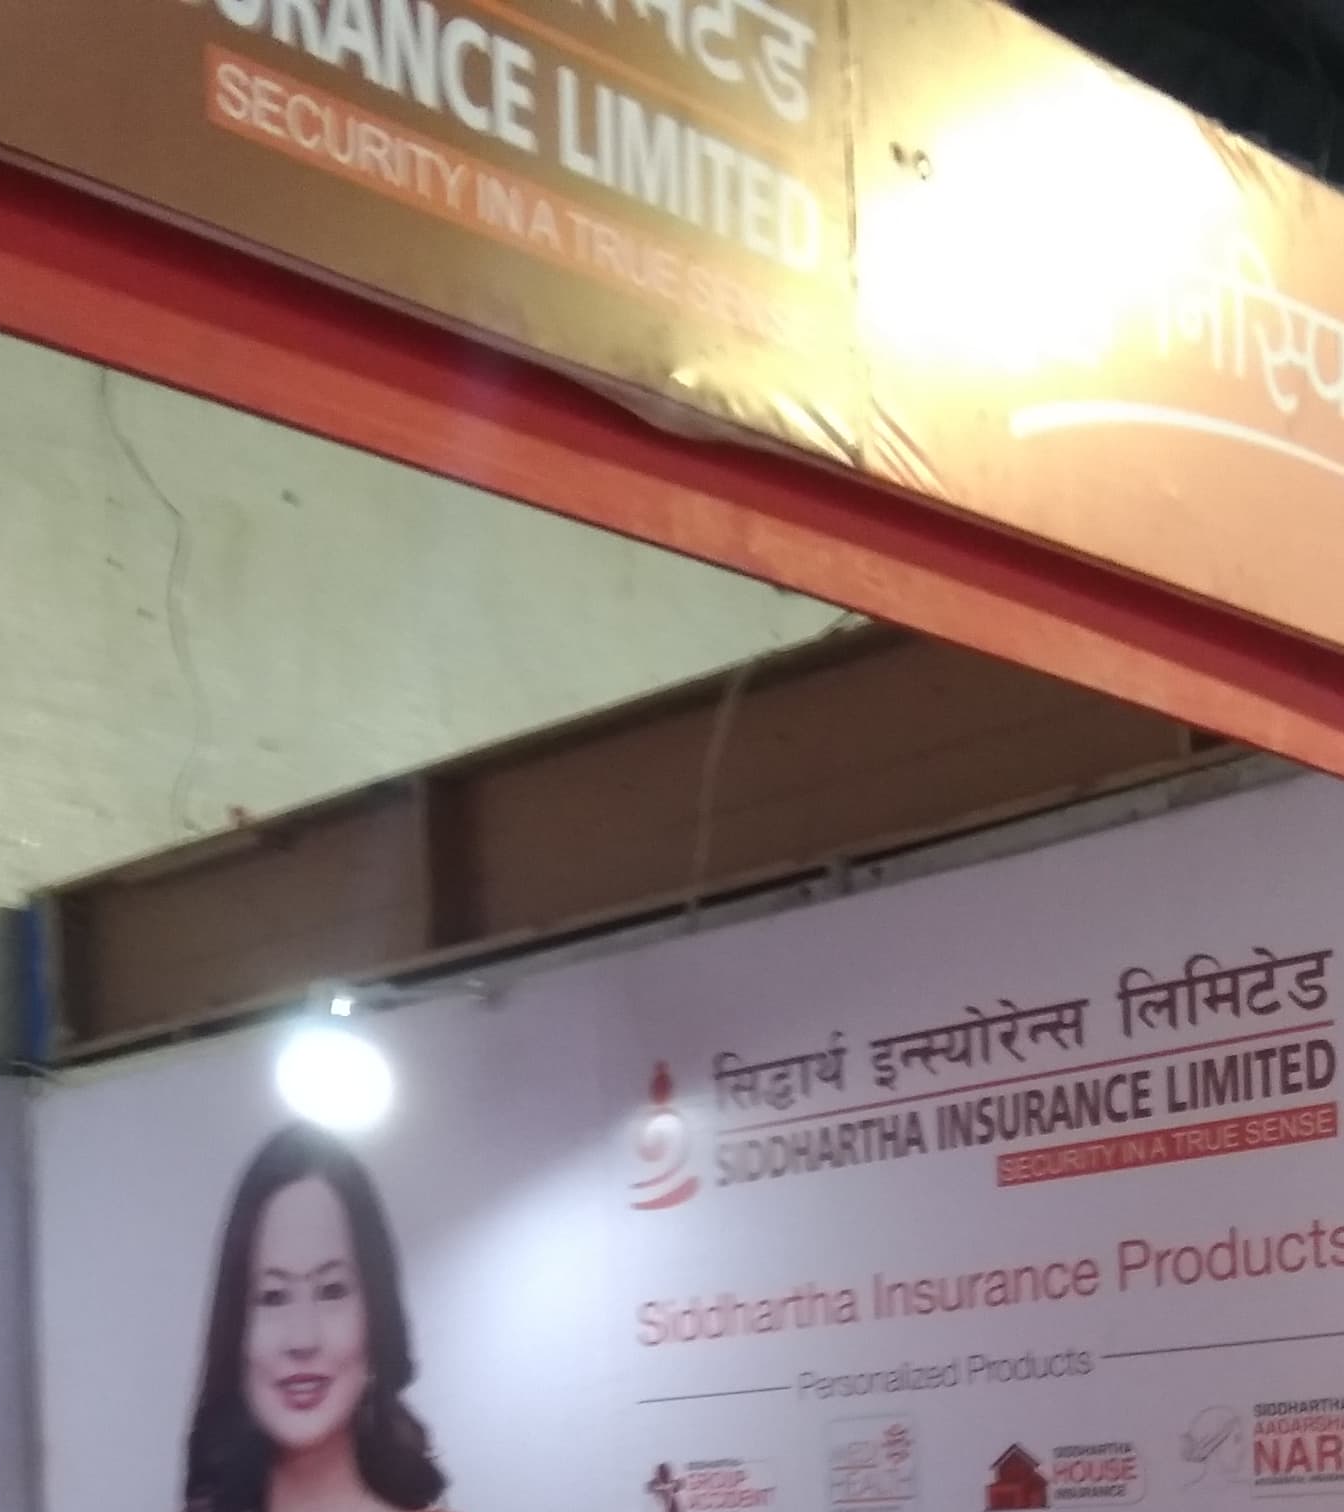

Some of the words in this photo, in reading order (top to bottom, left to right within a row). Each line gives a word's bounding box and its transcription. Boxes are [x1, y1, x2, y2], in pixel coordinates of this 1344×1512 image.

[215, 62, 468, 213] SECURITY
[474, 178, 522, 237] IN
[521, 194, 564, 252] A
[567, 211, 680, 302] TRUE
[558, 64, 824, 274] LIMITED
[1116, 946, 1334, 1038] लिमिटेड
[716, 1110, 928, 1187] SIDDHARTHA
[936, 1068, 1154, 1151] INSURANCE
[1166, 1037, 1337, 1114] LIMITED
[999, 1143, 1115, 1183] SECURITY
[1119, 1139, 1147, 1164] IN
[1148, 1137, 1168, 1159] A
[1171, 1123, 1240, 1155] TRUE
[1244, 1107, 1334, 1146] SENSE
[635, 1283, 860, 1348] Siddhartha
[873, 1252, 1100, 1321] Insurance
[966, 1349, 1094, 1387] Products
[1052, 1457, 1138, 1484] HOUSE
